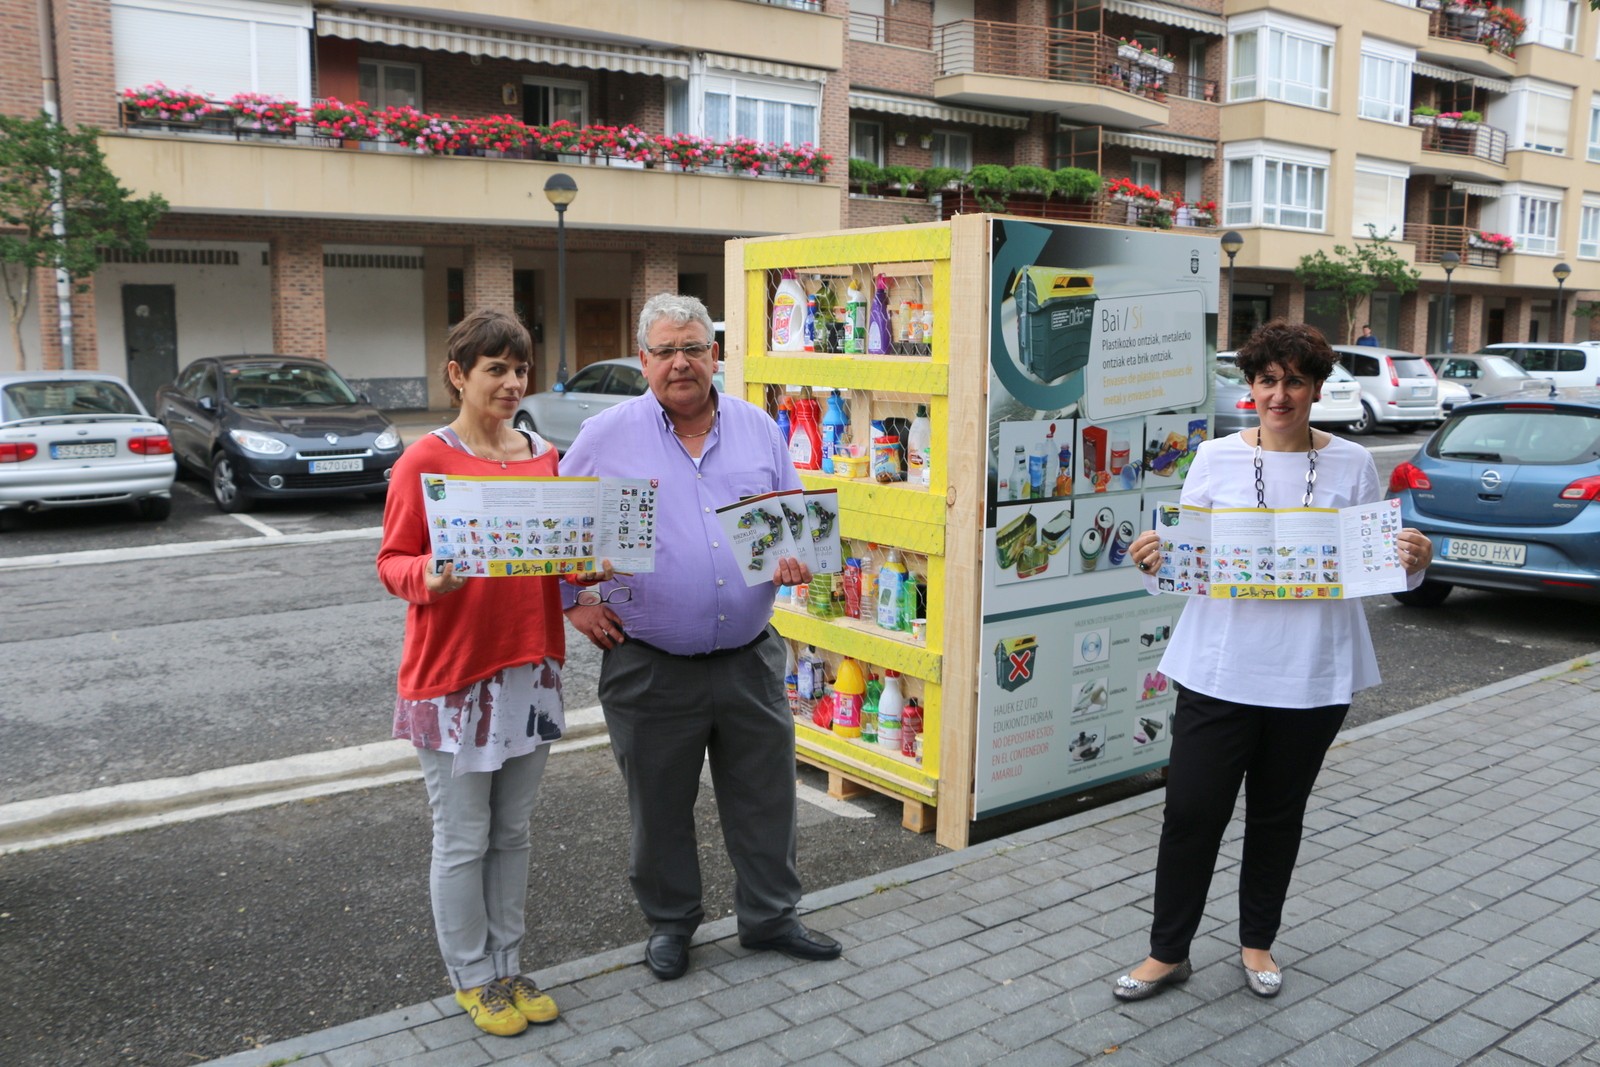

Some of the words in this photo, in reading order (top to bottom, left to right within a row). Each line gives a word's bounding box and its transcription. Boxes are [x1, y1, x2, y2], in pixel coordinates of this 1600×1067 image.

[1101, 309, 1120, 332] Bai
[1102, 336, 1136, 351] Plastikozko
[1161, 330, 1192, 344] metalezko
[1102, 355, 1126, 369] ontziak
[1126, 355, 1137, 366] eta
[1127, 372, 1137, 384] de
[1451, 541, 1488, 558] 9880
[1492, 545, 1522, 561] HXV
[993, 702, 1015, 717] HAUEK
[1016, 699, 1024, 712] EZ
[1024, 696, 1039, 711] UTZI
[992, 715, 1030, 733] EDUKIONTZI
[1030, 710, 1054, 725] HORIAN
[992, 737, 1002, 750] NO
[1003, 728, 1036, 748] DEPOSITAR
[1036, 725, 1055, 740] ESTOS
[992, 754, 1000, 767] EN
[1001, 752, 1009, 764] EL
[1009, 742, 1050, 762] CONTENEDOR
[991, 764, 1023, 782] AMARILLO
